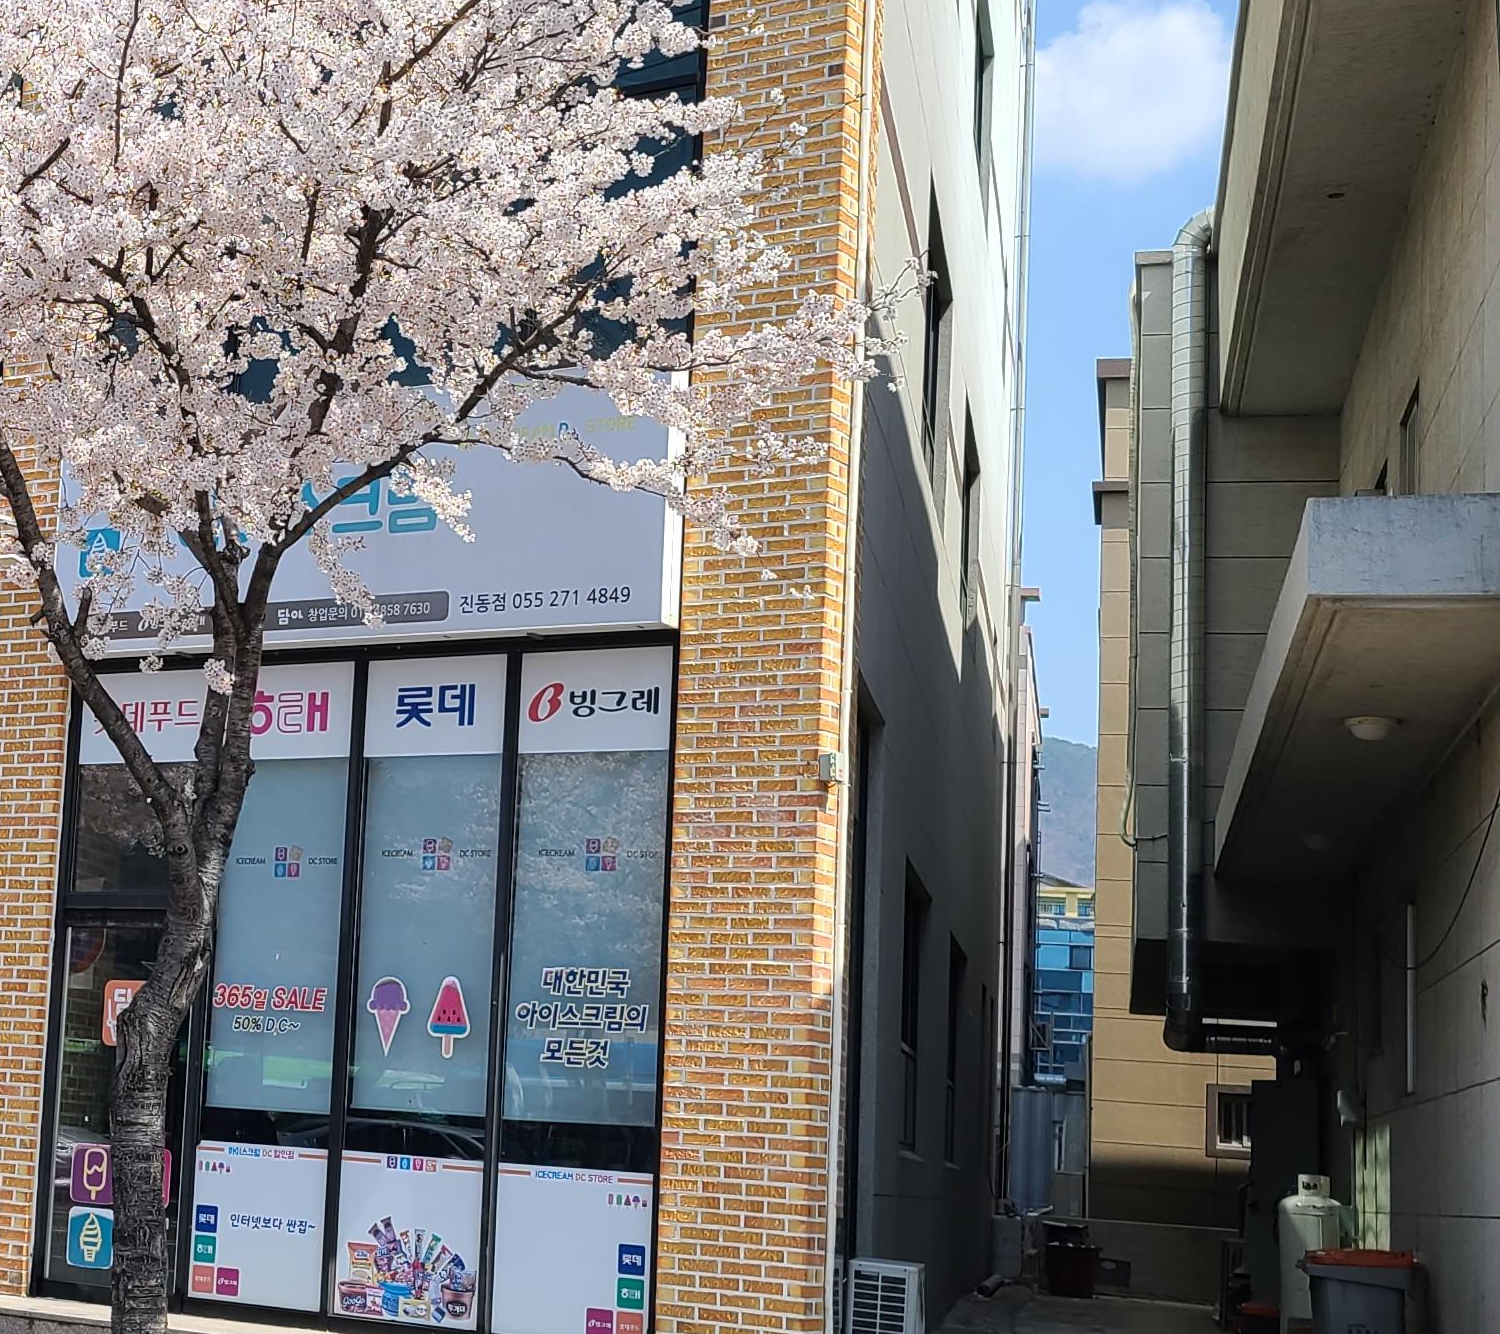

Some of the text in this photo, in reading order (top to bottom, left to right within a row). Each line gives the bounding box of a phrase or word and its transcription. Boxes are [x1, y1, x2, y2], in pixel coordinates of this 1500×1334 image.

[308, 606, 348, 623] 창업문의
[403, 602, 430, 615] 7630
[460, 586, 631, 614] 진동점 055 271 4849
[395, 683, 476, 728] 롯데
[569, 685, 660, 718] 빙그레
[541, 967, 631, 998] 대한민국
[212, 983, 328, 1012] 365일 SALE
[233, 1015, 262, 1032] 50%
[515, 1001, 649, 1033] 아이스크림의
[540, 1038, 610, 1069] 모든것
[228, 1146, 260, 1157] 아이스크림
[274, 1150, 295, 1160] 할인점
[535, 1171, 613, 1184] ICECREAM DC STORE
[229, 1213, 283, 1231] 인터넷보다
